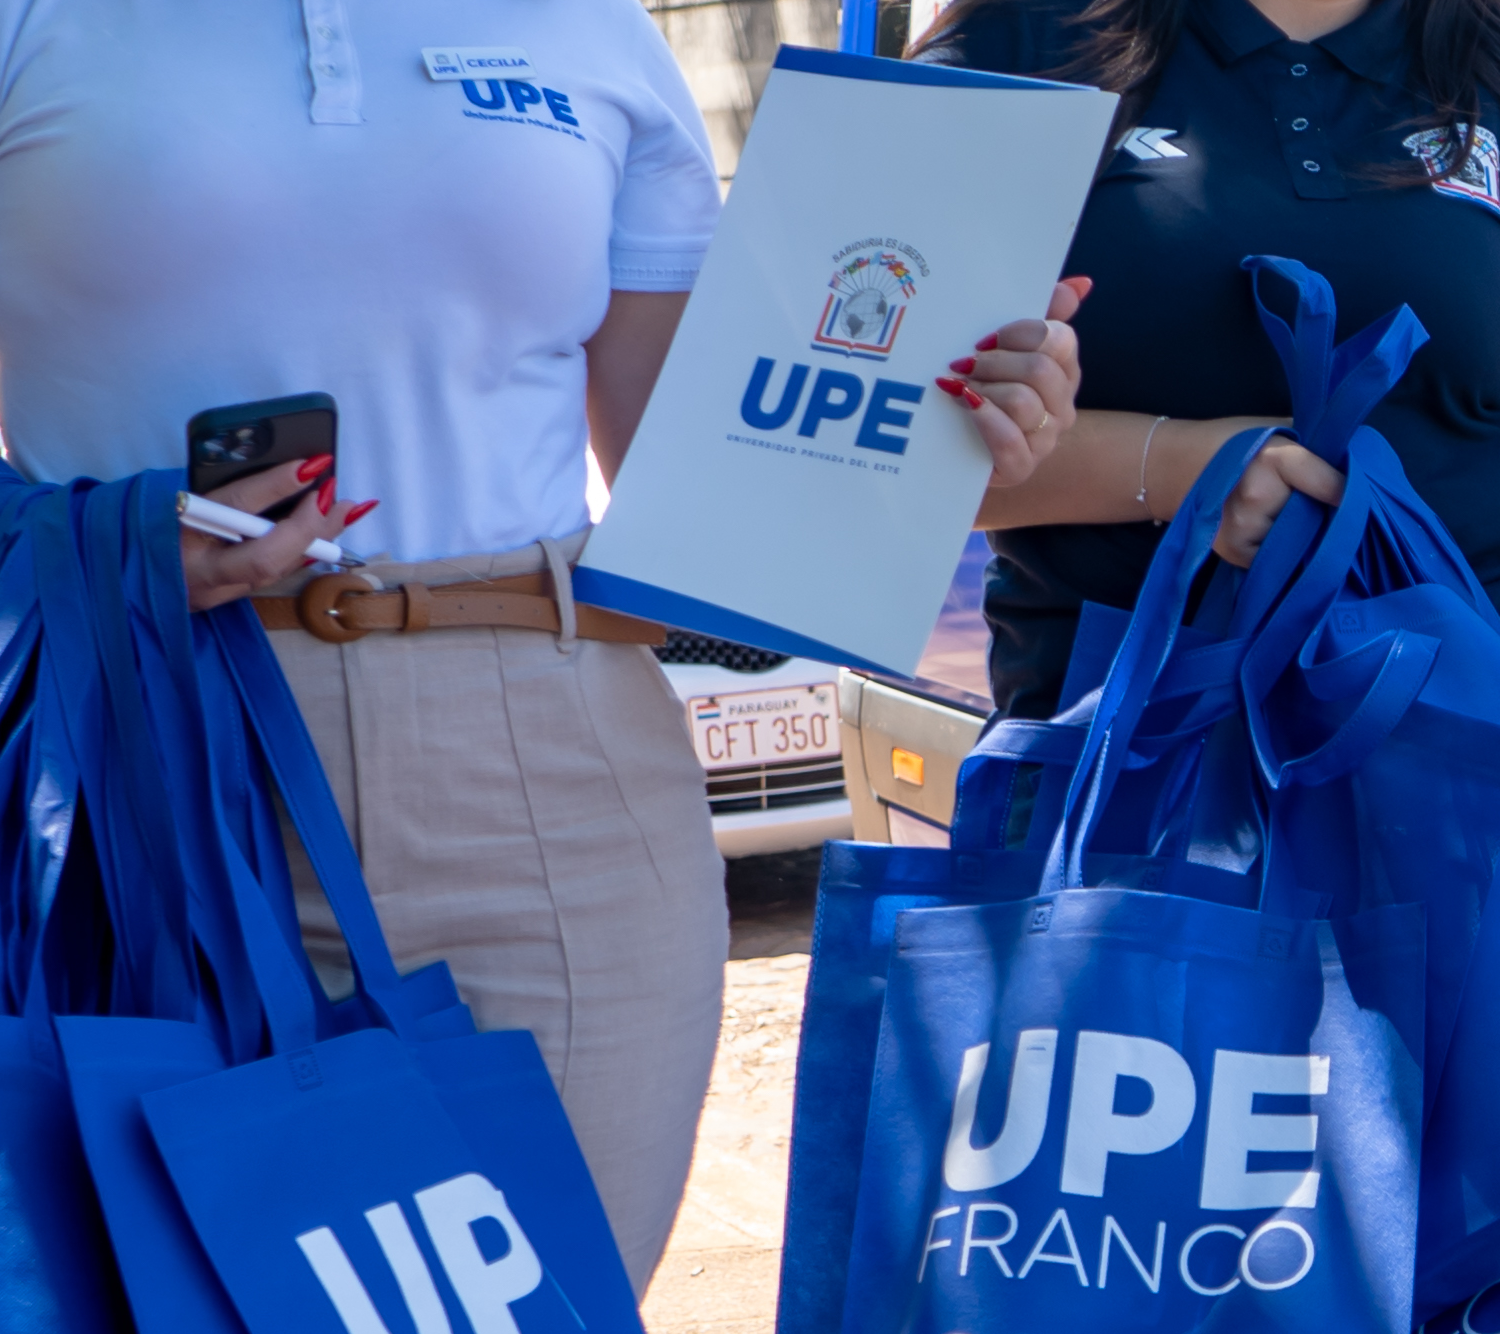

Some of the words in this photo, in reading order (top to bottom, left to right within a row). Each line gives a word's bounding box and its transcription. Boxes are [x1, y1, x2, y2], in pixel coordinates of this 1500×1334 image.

[466, 58, 530, 68] CECILIA
[461, 79, 580, 128] UPE
[831, 237, 884, 264] SABIDURIA
[885, 237, 898, 250] ES
[897, 242, 931, 278] LIBERTAD
[740, 355, 927, 457] UPE
[726, 433, 798, 455] UNIVERSIDAD
[800, 448, 846, 465] PRIVADA
[849, 458, 869, 470] DEL
[873, 462, 901, 476] ESTE
[728, 699, 799, 717] PARAGUAY
[706, 719, 759, 761] CFT
[772, 712, 828, 753] 350
[944, 1028, 1331, 1211] UPE
[917, 1202, 1316, 1297] FRANCO
